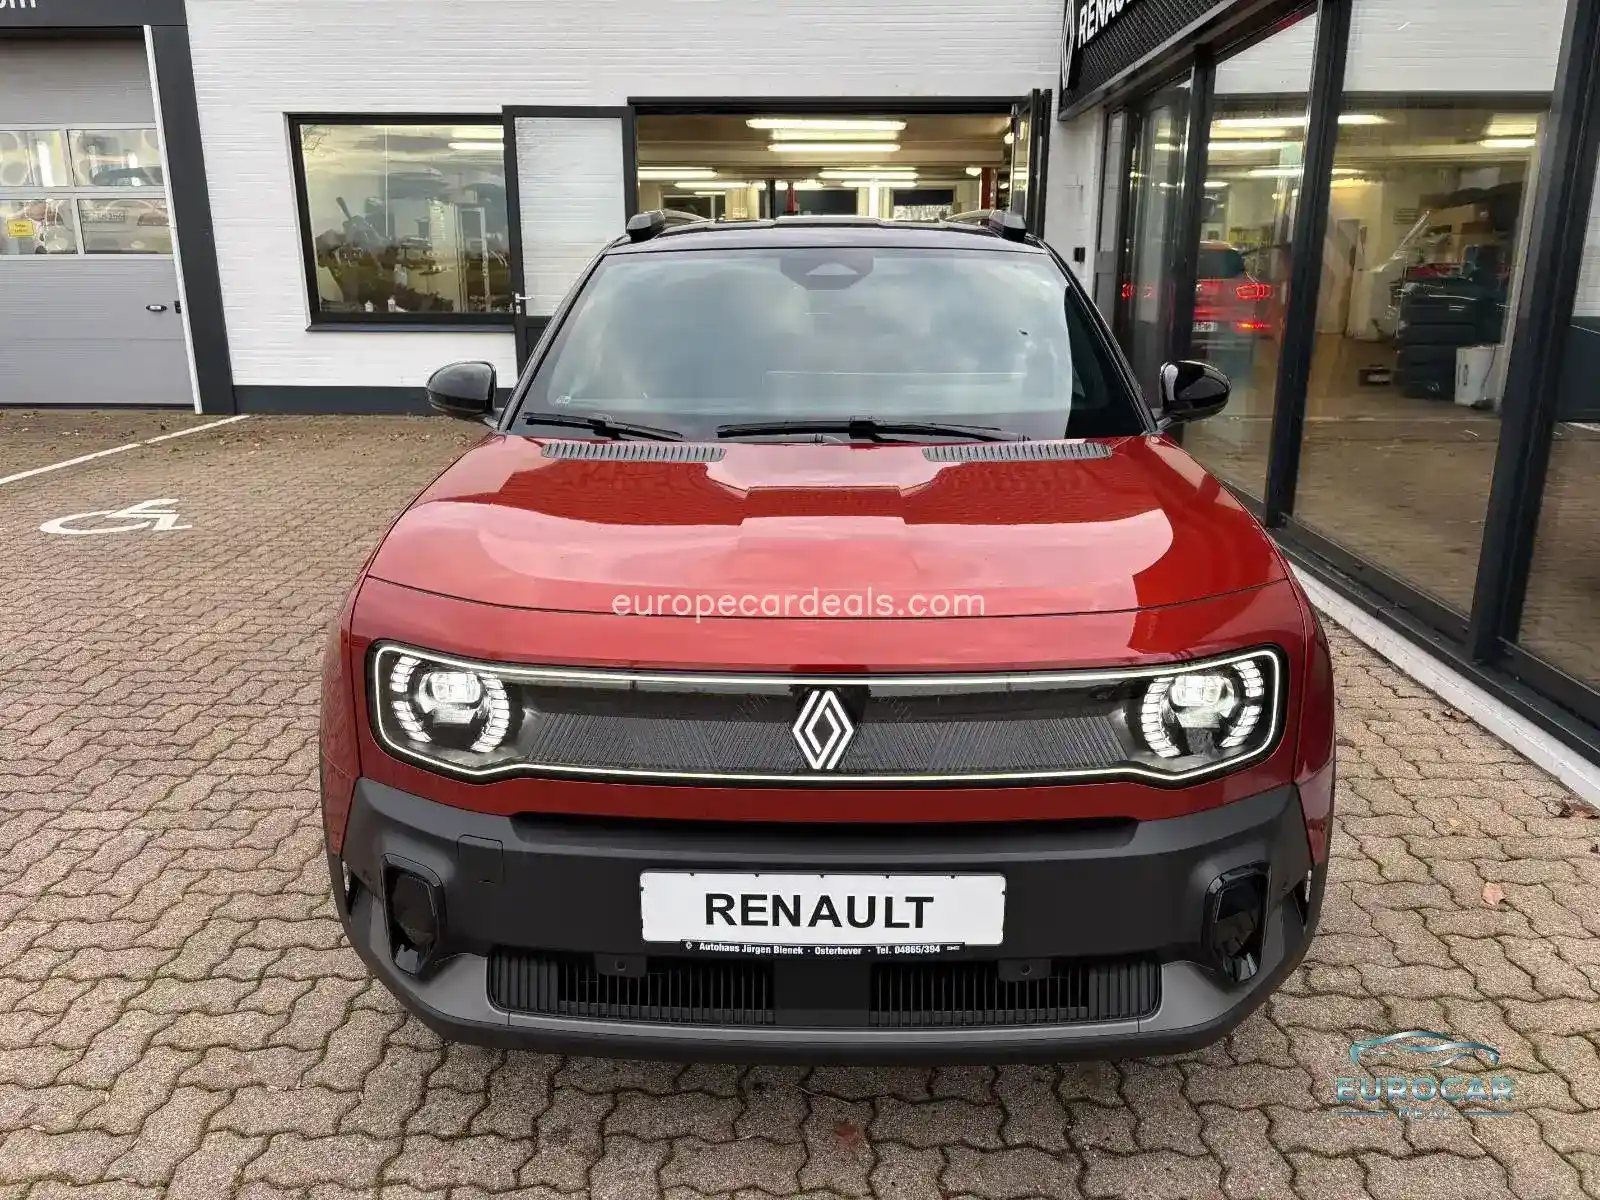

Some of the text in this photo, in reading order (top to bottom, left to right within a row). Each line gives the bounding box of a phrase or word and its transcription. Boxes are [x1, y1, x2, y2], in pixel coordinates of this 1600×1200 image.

[1078, 0, 1131, 49] RENA
[704, 892, 935, 929] RENAULT
[699, 942, 740, 953] Autohaus
[741, 944, 771, 954] Jürgen
[814, 946, 862, 955] Osterhever
[875, 946, 892, 954] Tel.
[894, 945, 941, 954] 04865/394
